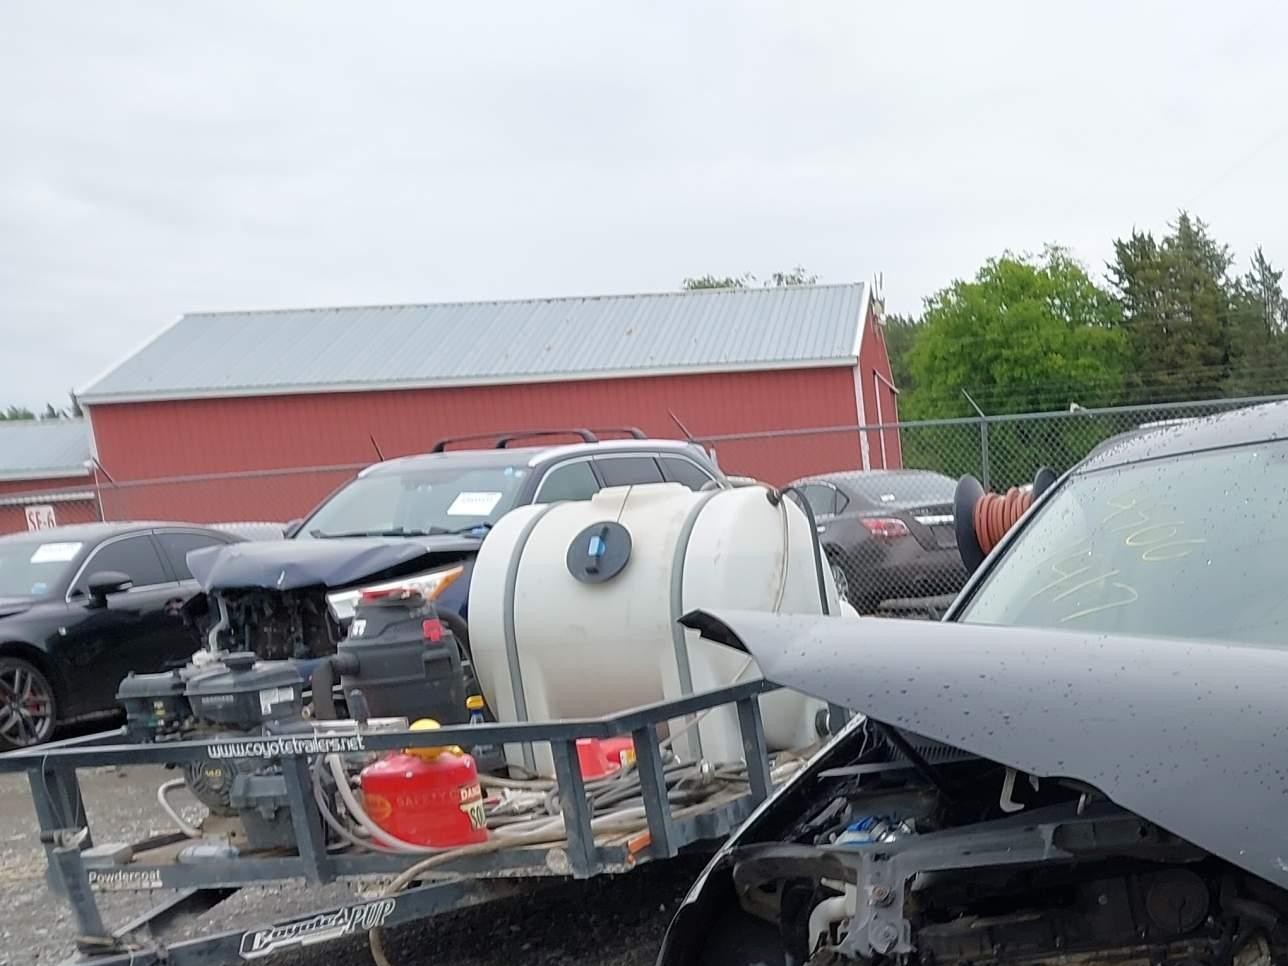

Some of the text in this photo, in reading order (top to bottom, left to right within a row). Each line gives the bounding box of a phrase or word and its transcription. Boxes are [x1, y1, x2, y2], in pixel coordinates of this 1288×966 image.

[207, 733, 365, 759] www.coyotetrailers.net
[88, 869, 160, 884] Powdercoat
[347, 899, 396, 933] PUP
